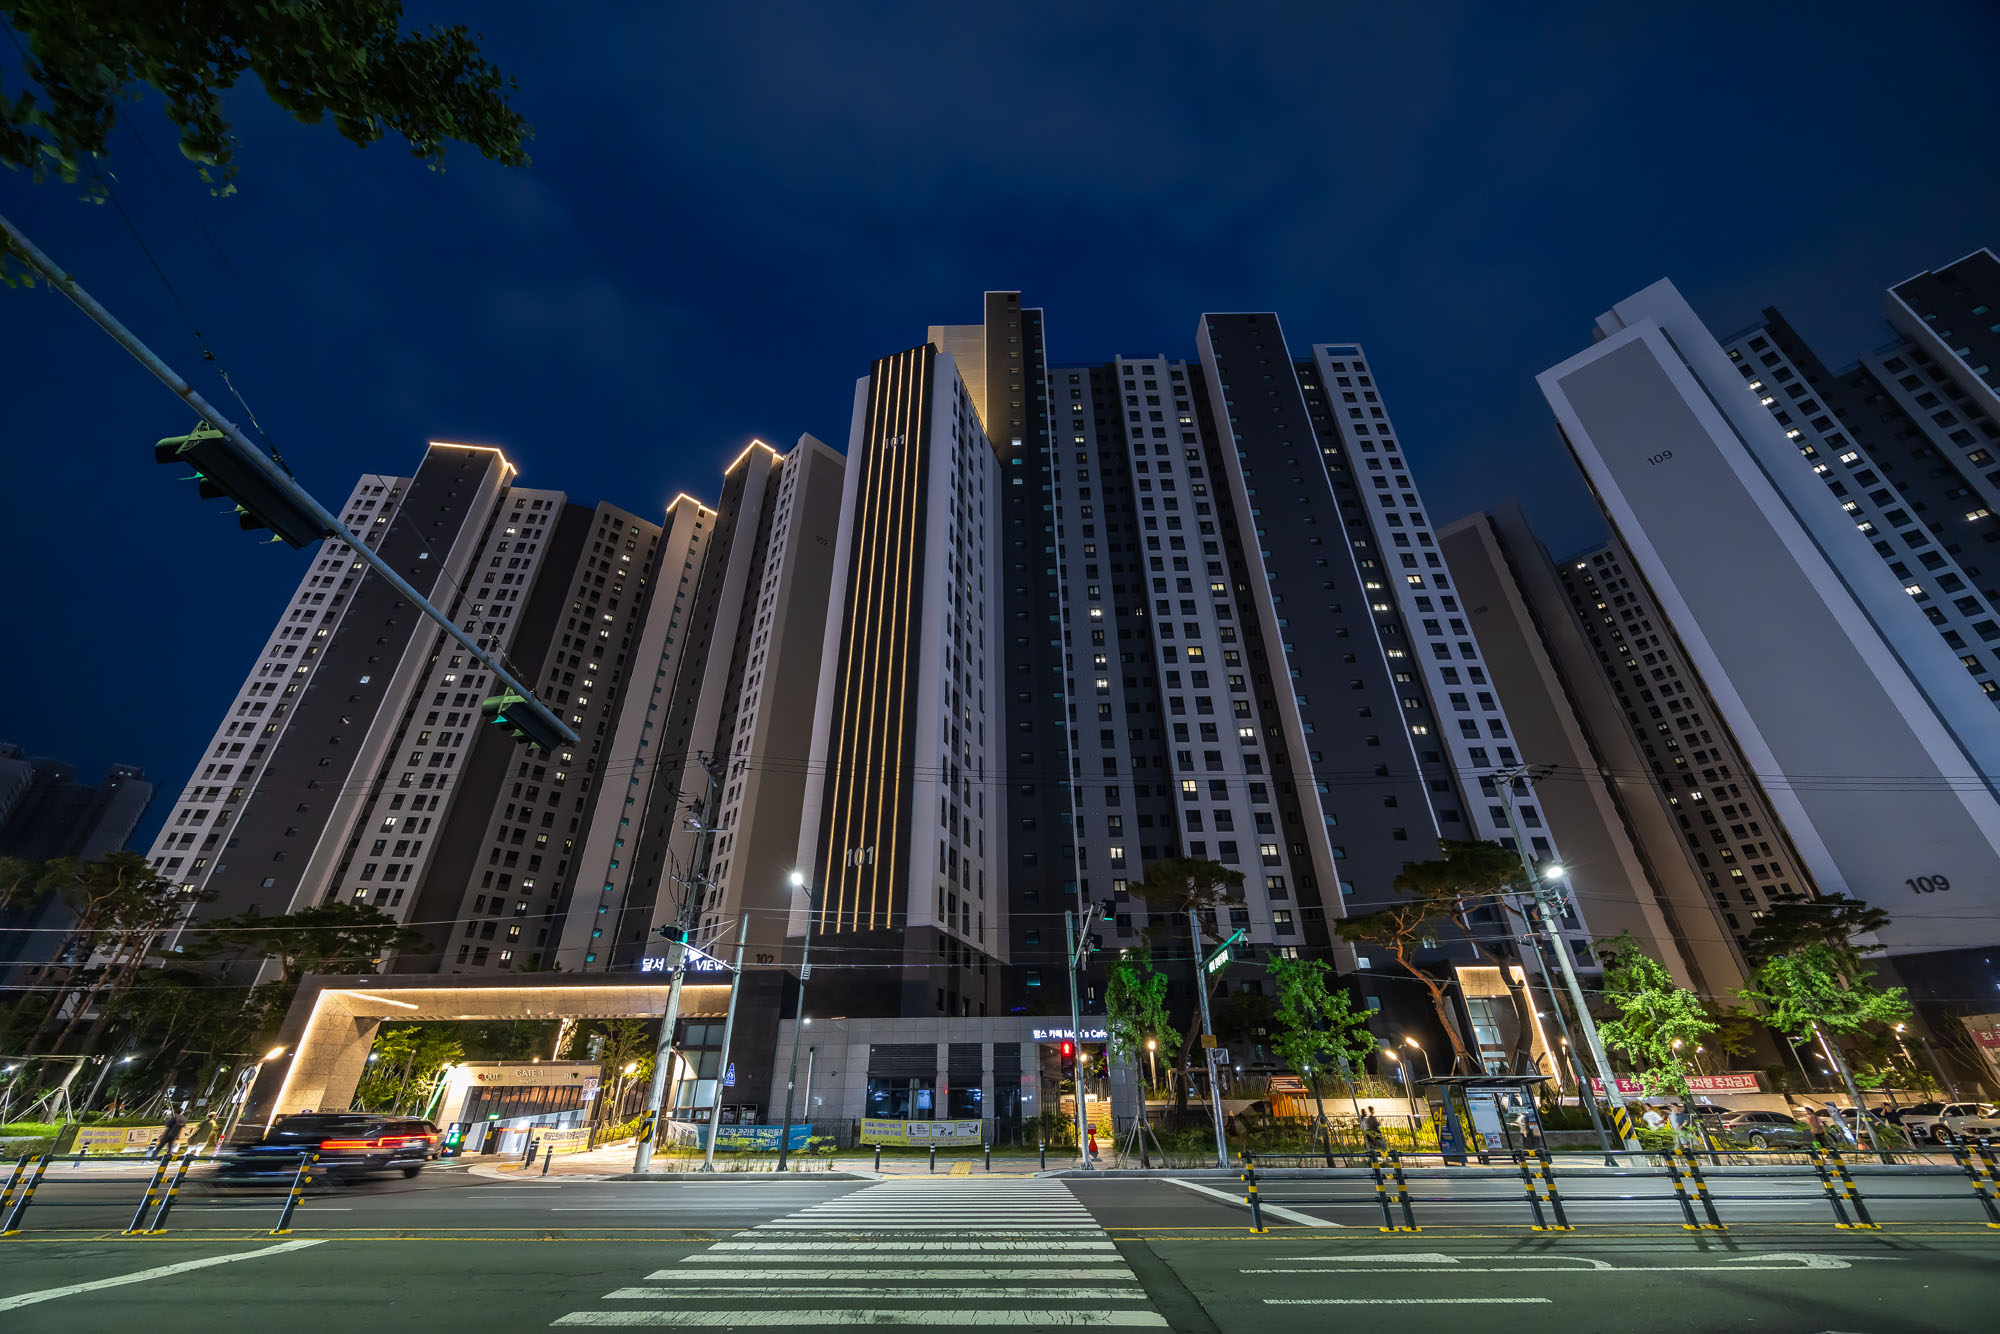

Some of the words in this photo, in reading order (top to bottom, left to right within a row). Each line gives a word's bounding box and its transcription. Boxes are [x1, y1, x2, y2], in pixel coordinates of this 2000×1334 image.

[1647, 450, 1673, 466] 109
[846, 846, 874, 867] 101
[1905, 875, 1951, 894] 109
[641, 958, 665, 971] 달서
[695, 959, 727, 971] VIEW
[756, 953, 774, 966] 102
[1033, 1029, 1048, 1038] 맘스
[1048, 1029, 1062, 1038] 카페
[1090, 1029, 1108, 1038] Cafe
[484, 1073, 499, 1081] OUT
[515, 1069, 537, 1077] GATE
[1714, 1076, 1754, 1088] 주차금지
